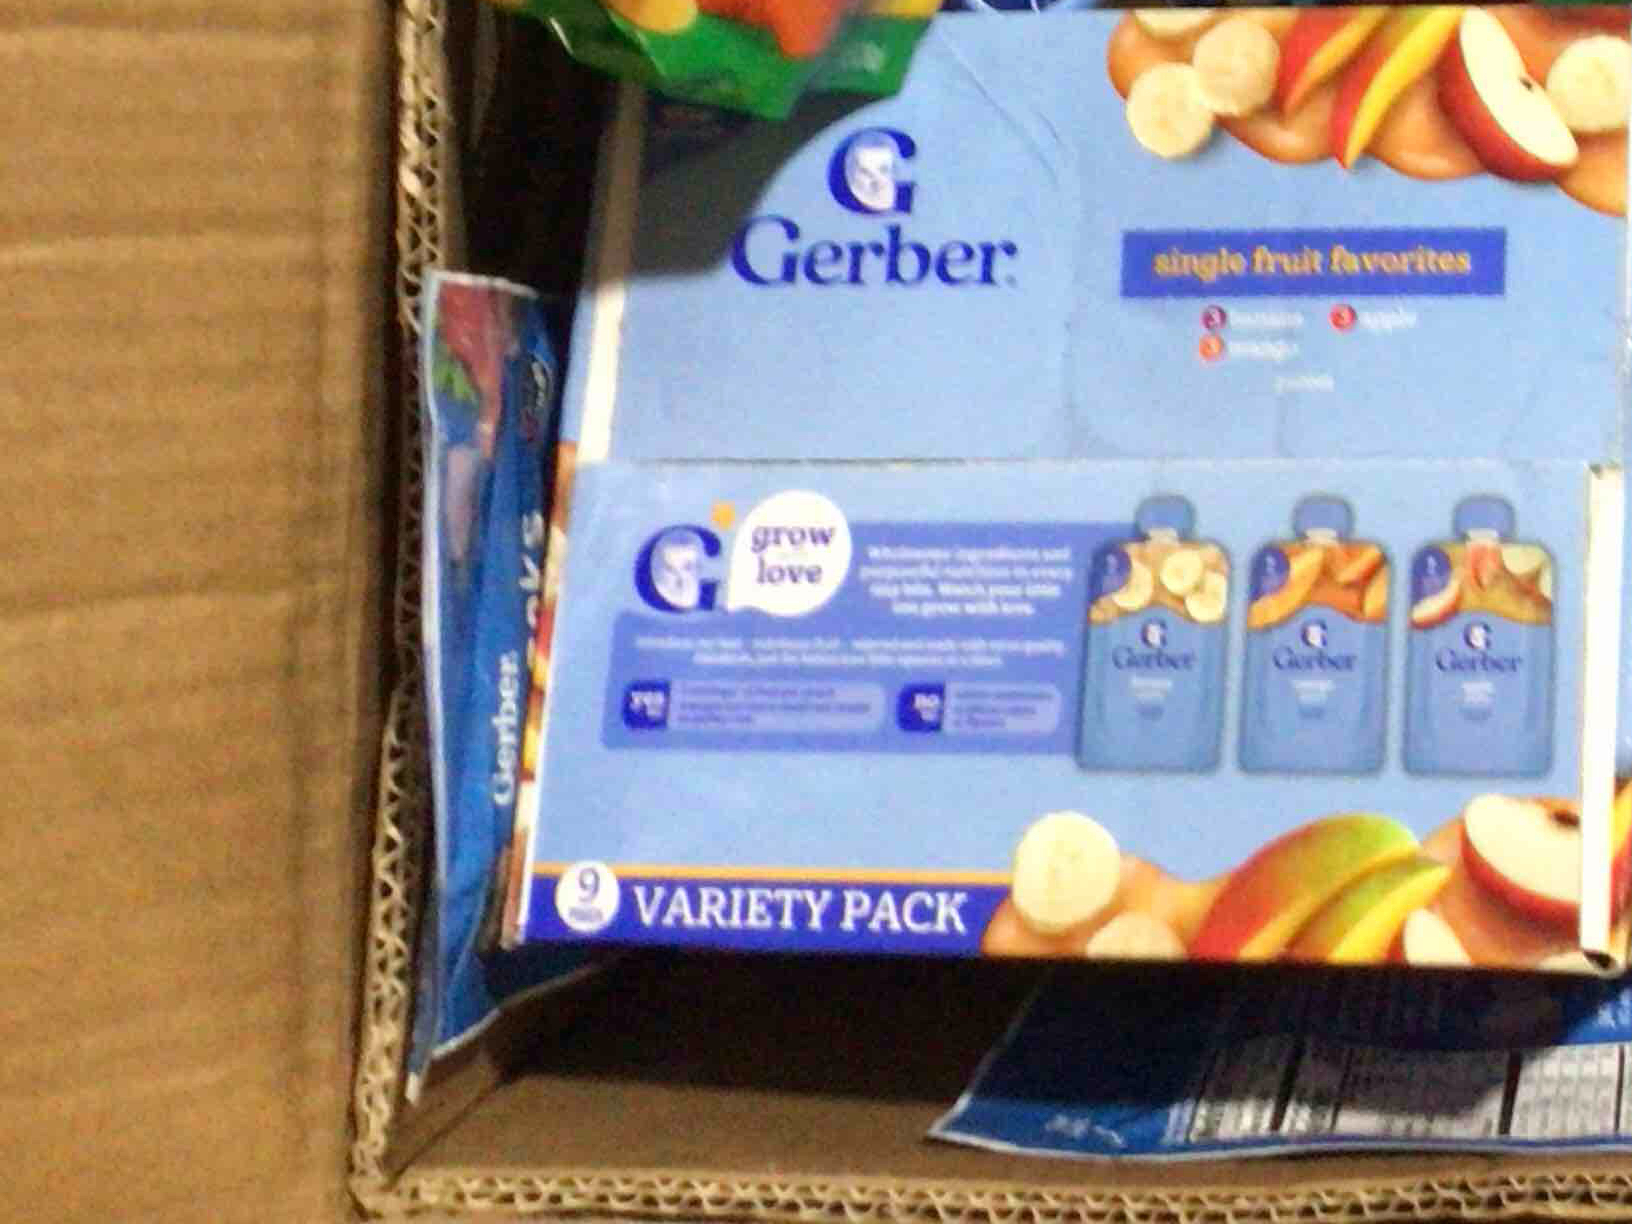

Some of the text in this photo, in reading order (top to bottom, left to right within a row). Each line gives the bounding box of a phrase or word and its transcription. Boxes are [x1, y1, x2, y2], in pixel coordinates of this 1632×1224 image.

[730, 214, 1018, 287] Gerber
[1153, 244, 1472, 283] single fruit favorites
[751, 520, 836, 554] grow
[756, 559, 823, 585] love
[575, 865, 967, 934] 9 VARIETY PACK
